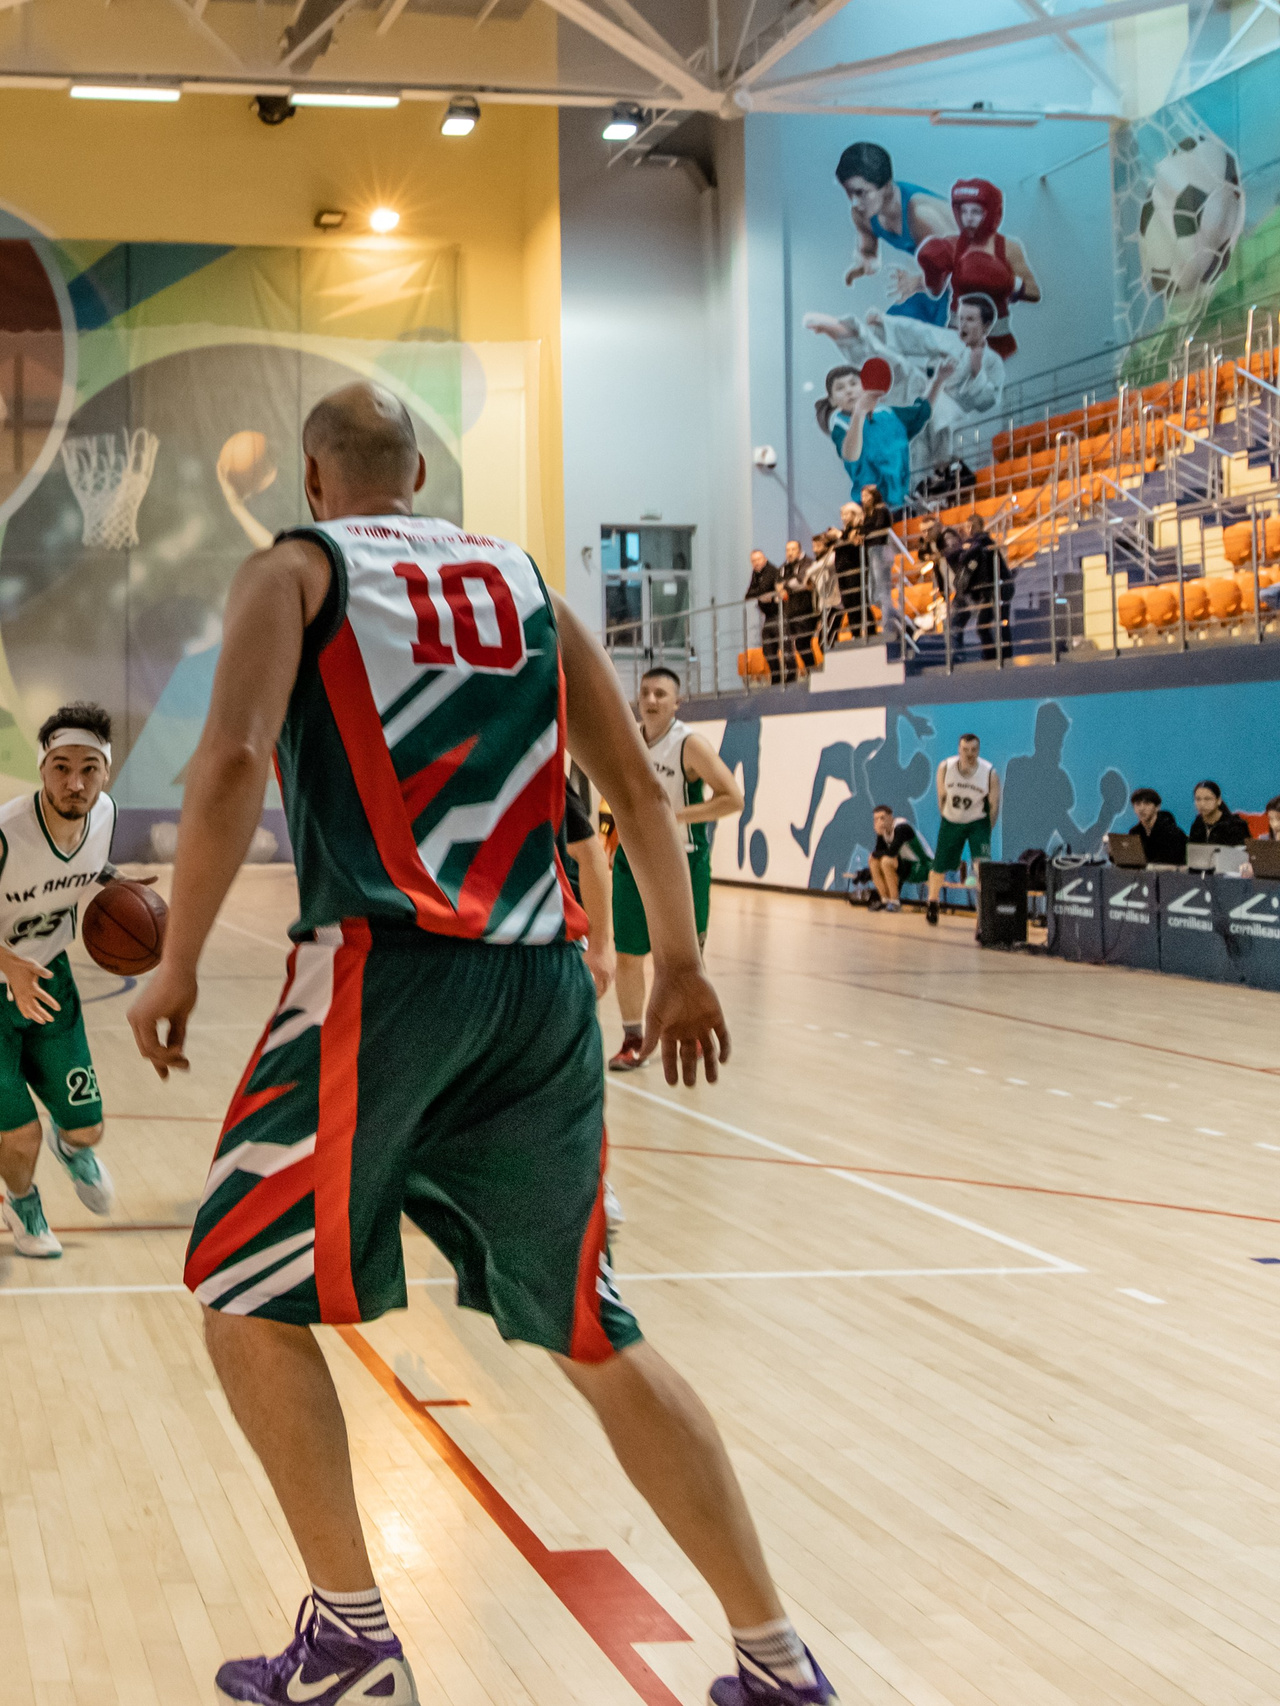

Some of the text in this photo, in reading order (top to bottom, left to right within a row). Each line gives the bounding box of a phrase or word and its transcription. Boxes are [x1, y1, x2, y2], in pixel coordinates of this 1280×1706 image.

[392, 561, 525, 673] 10
[5, 884, 37, 902] НК
[1167, 916, 1213, 932] cornilleau
